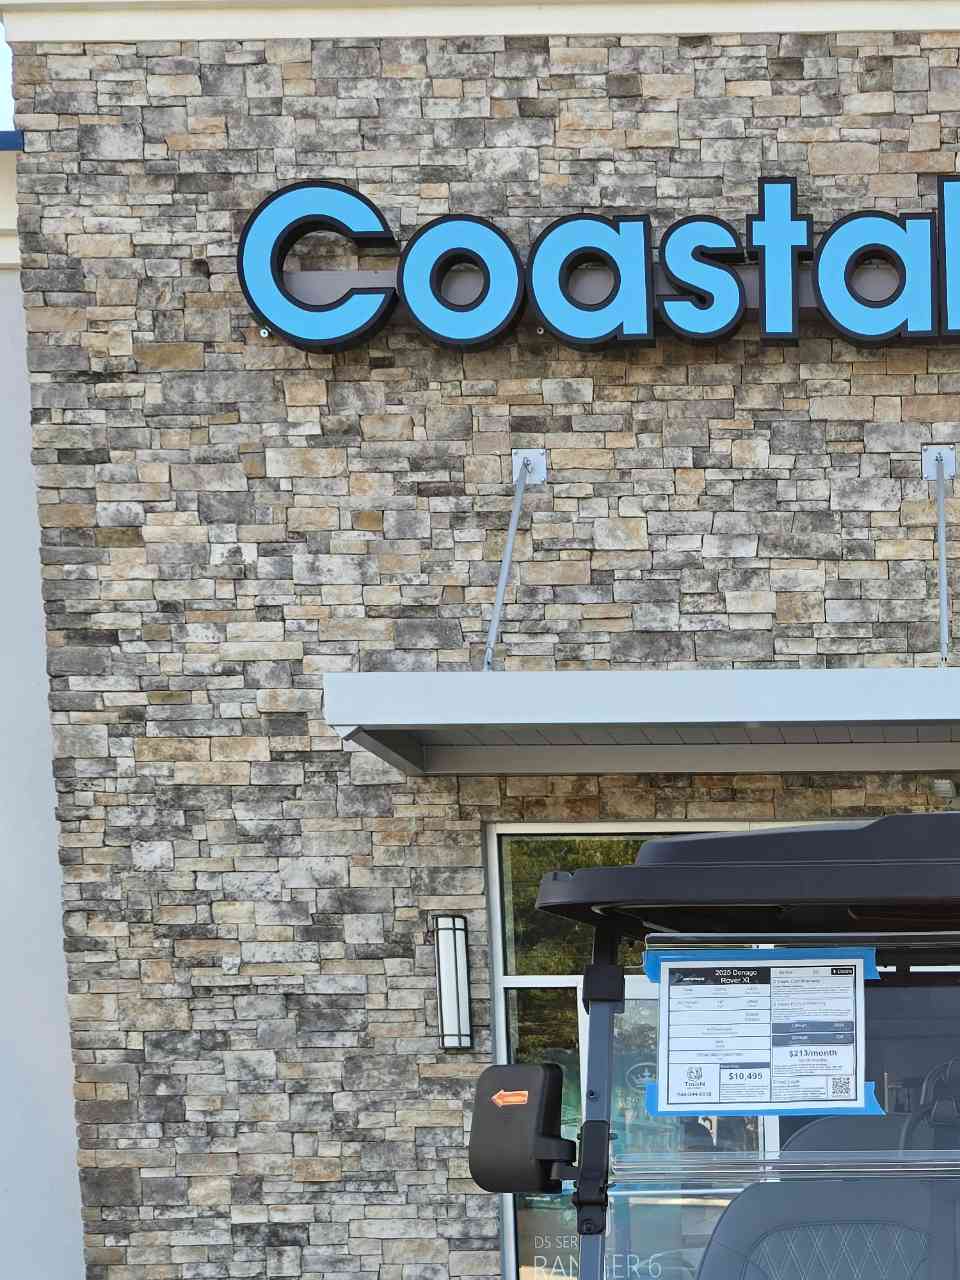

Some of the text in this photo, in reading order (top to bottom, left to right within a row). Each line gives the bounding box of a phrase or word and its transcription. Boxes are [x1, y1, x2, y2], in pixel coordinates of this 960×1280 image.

[556, 1235, 578, 1249] SER
[533, 1253, 662, 1280] RANER 6
